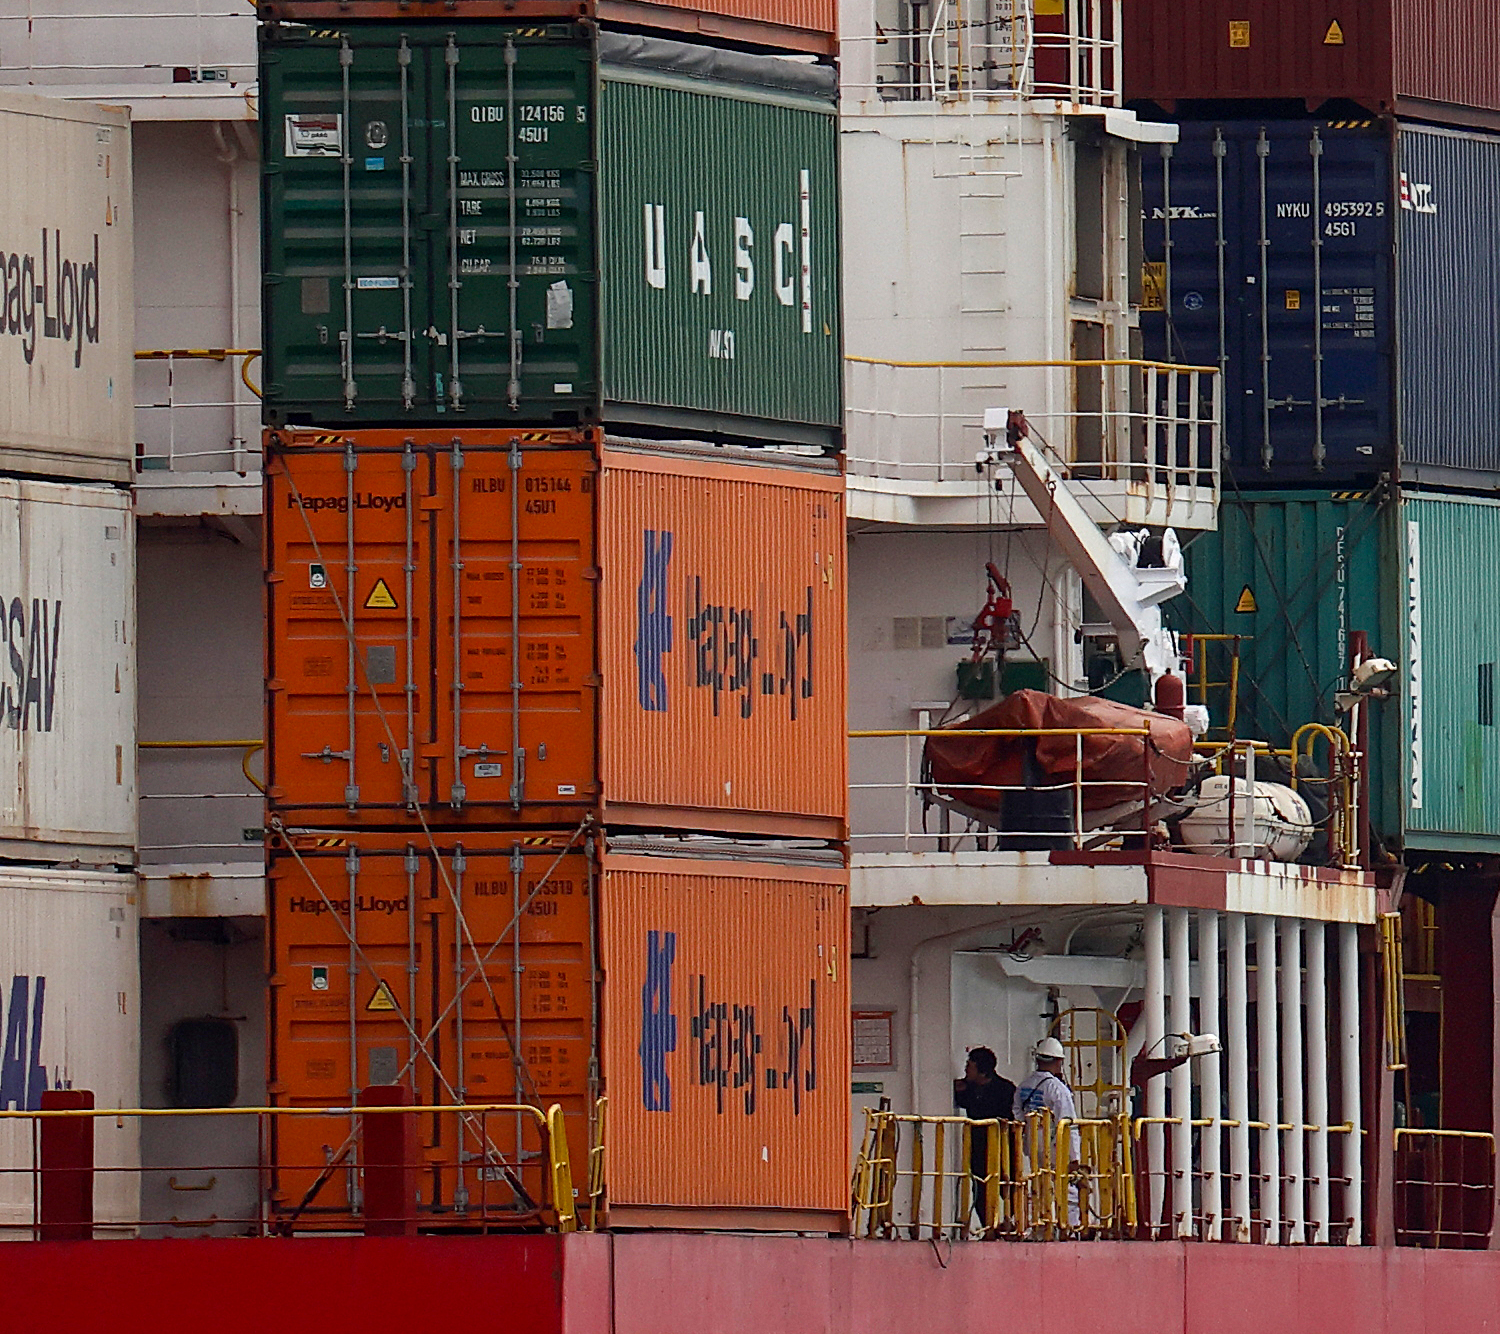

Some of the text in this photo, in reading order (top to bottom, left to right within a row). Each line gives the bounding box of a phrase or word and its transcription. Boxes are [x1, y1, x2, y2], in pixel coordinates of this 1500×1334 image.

[470, 104, 587, 124] QIBU 124156 5
[518, 127, 550, 143] 45U1
[460, 199, 483, 217] TARE
[1152, 206, 1200, 220] NYK
[1276, 202, 1310, 218] NYKU
[1324, 201, 1374, 217] 495392
[460, 228, 478, 246] NET
[1324, 221, 1357, 237] 45G1
[644, 202, 795, 307] UASC
[0, 226, 100, 369] ag-Lloyd
[472, 477, 506, 494] HLBU
[287, 492, 407, 513] Hapag-Lloyd
[524, 499, 557, 515] 45U1
[0, 595, 62, 733] SAV
[289, 895, 409, 916] Hapag-Lloyd
